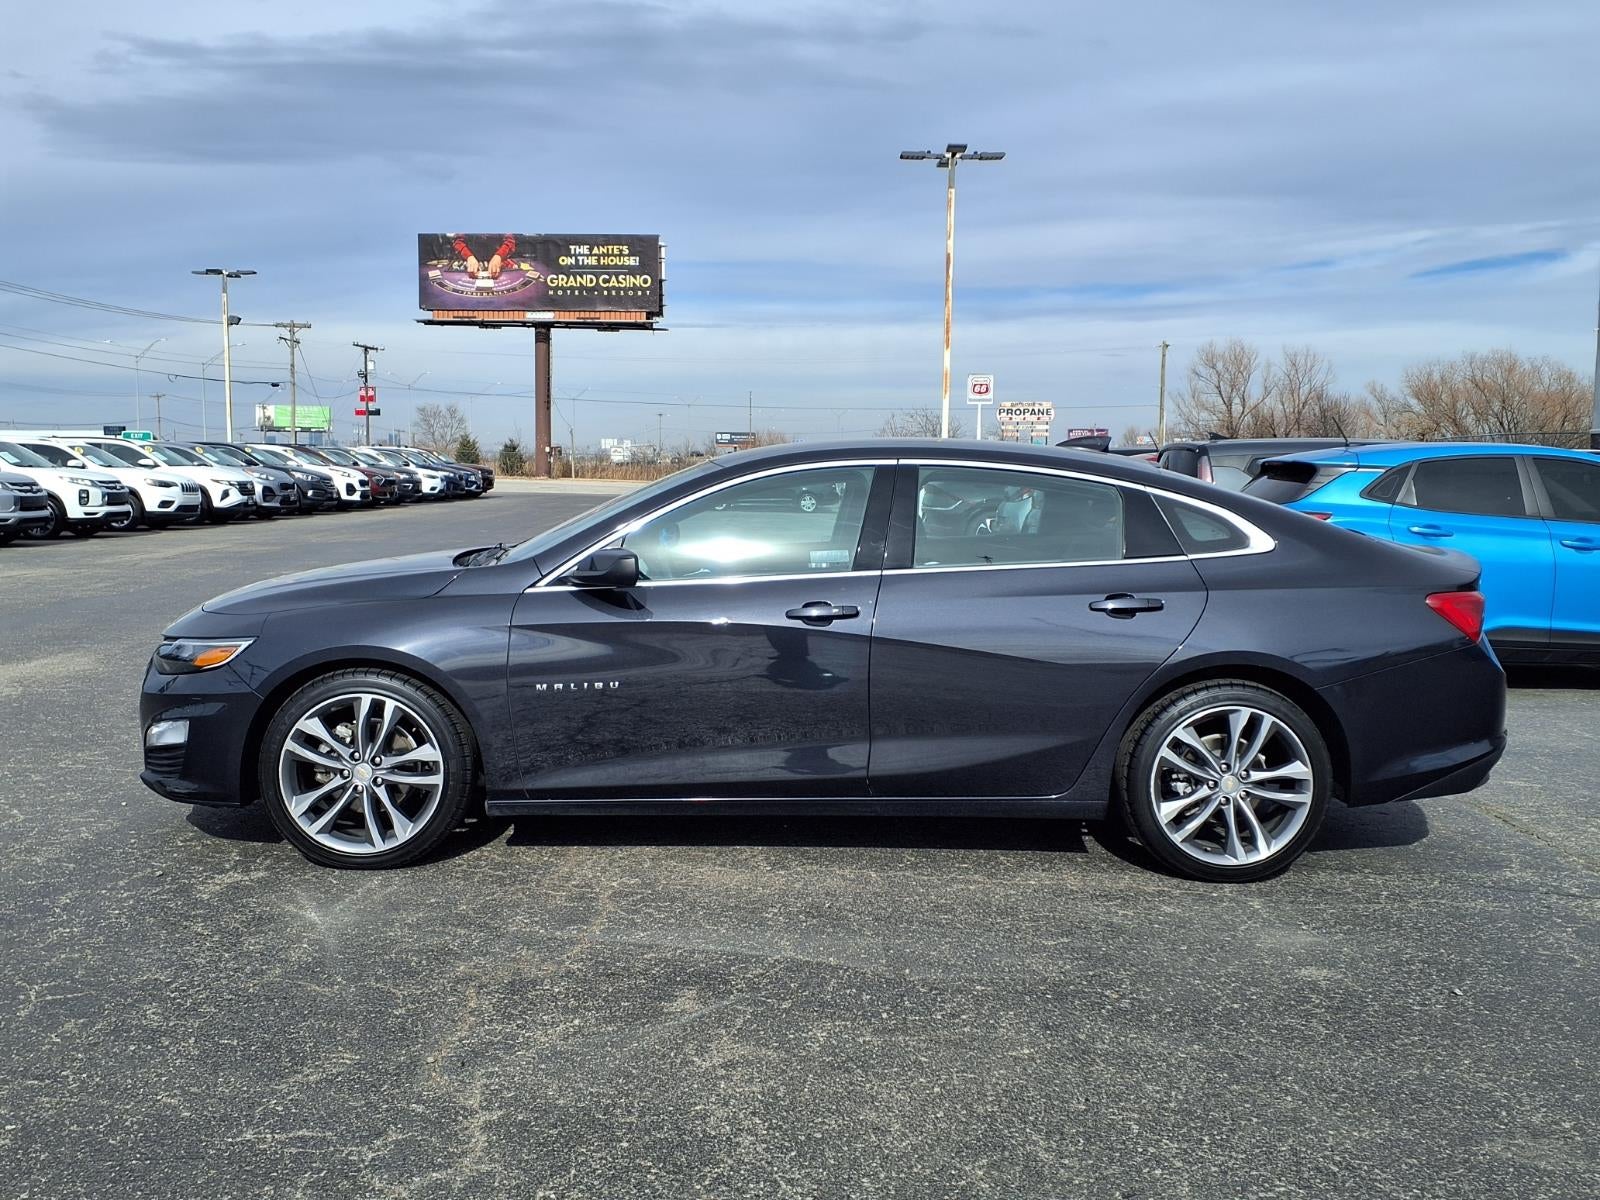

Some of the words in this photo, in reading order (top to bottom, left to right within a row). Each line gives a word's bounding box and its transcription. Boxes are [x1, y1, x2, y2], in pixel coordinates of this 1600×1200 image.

[569, 245, 590, 254] THE
[592, 245, 629, 254] ANTE'S
[558, 256, 575, 265] ON
[577, 256, 598, 265] THE
[600, 256, 640, 266] HOUSE!
[547, 274, 596, 287] GRAND
[599, 274, 652, 287] CASINO
[974, 384, 987, 393] 66
[998, 408, 1052, 416] PROPANE
[535, 681, 620, 691] MALIBU
